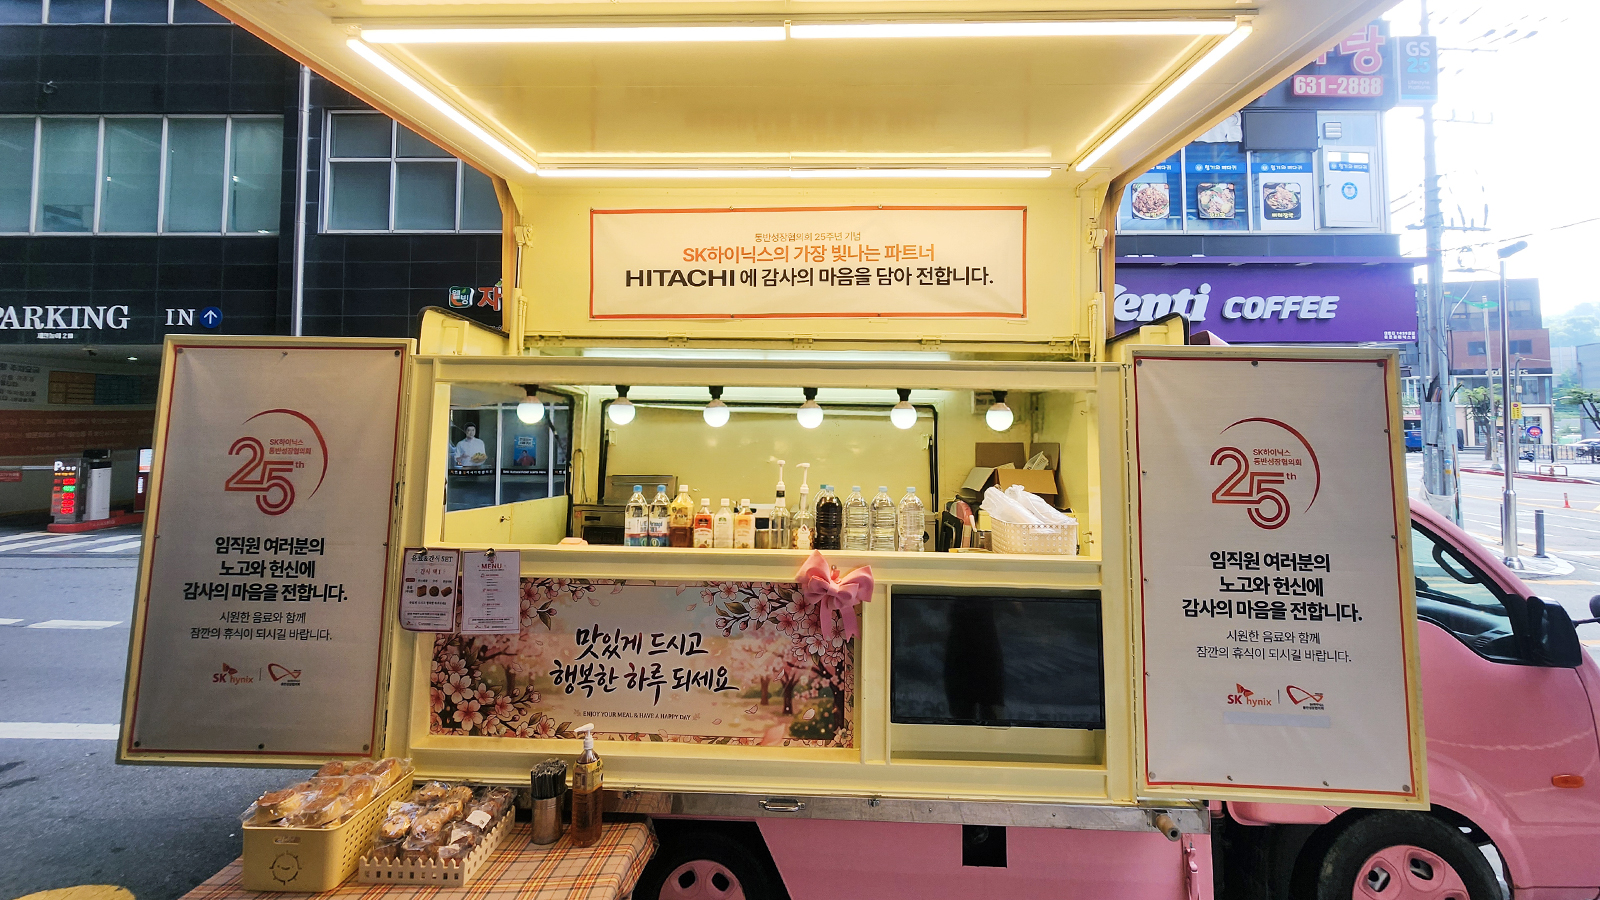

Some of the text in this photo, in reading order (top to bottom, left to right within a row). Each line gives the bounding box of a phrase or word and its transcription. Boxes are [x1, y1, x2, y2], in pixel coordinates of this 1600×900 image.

[1316, 25, 1386, 75] 탕
[1405, 41, 1431, 57] GS
[1406, 57, 1431, 74] 25
[1295, 76, 1382, 95] 631-2888
[755, 231, 861, 243] 동반성장협의회 25주년 기념
[682, 244, 935, 264] SK하이닉스의 가장 빛나는 파트너
[625, 266, 994, 287] HITACHI 에 감사의 마음을 담아 전합니다.
[451, 289, 470, 305] 웰빙
[1221, 295, 1341, 320] COFFEE
[0, 305, 196, 330] ARKING IN
[269, 447, 312, 455] 동반성장협의회
[1252, 448, 1291, 457] SK하이닉스
[1253, 458, 1302, 466] 동반성장협의회
[224, 436, 295, 516] 25
[1210, 446, 1297, 530] 25 th
[215, 536, 325, 555] 임직원 여러분의
[219, 559, 316, 578] 노고와 헌신에
[1209, 550, 1330, 572] 임직원 여러분의
[183, 582, 348, 602] 감사의 마음을 전합니다.
[1219, 576, 1324, 597] 노고와 헌신에
[219, 611, 307, 624] 시원한 음료와 함께
[1182, 599, 1362, 622] 감사의 마음을 전합니다.
[190, 627, 332, 641] 잠깐의 휴식이 되시길 바랍니다.
[574, 623, 709, 661] 맛있게 드시고
[1226, 630, 1320, 644] 시원한 음료와 함께
[1196, 646, 1352, 662] 잠깐의 휴식이 되시길 바랍니다.
[212, 673, 253, 685] SK hynix
[549, 659, 740, 706] 행복한 하루 되세요
[1227, 694, 1272, 707] SK hynix
